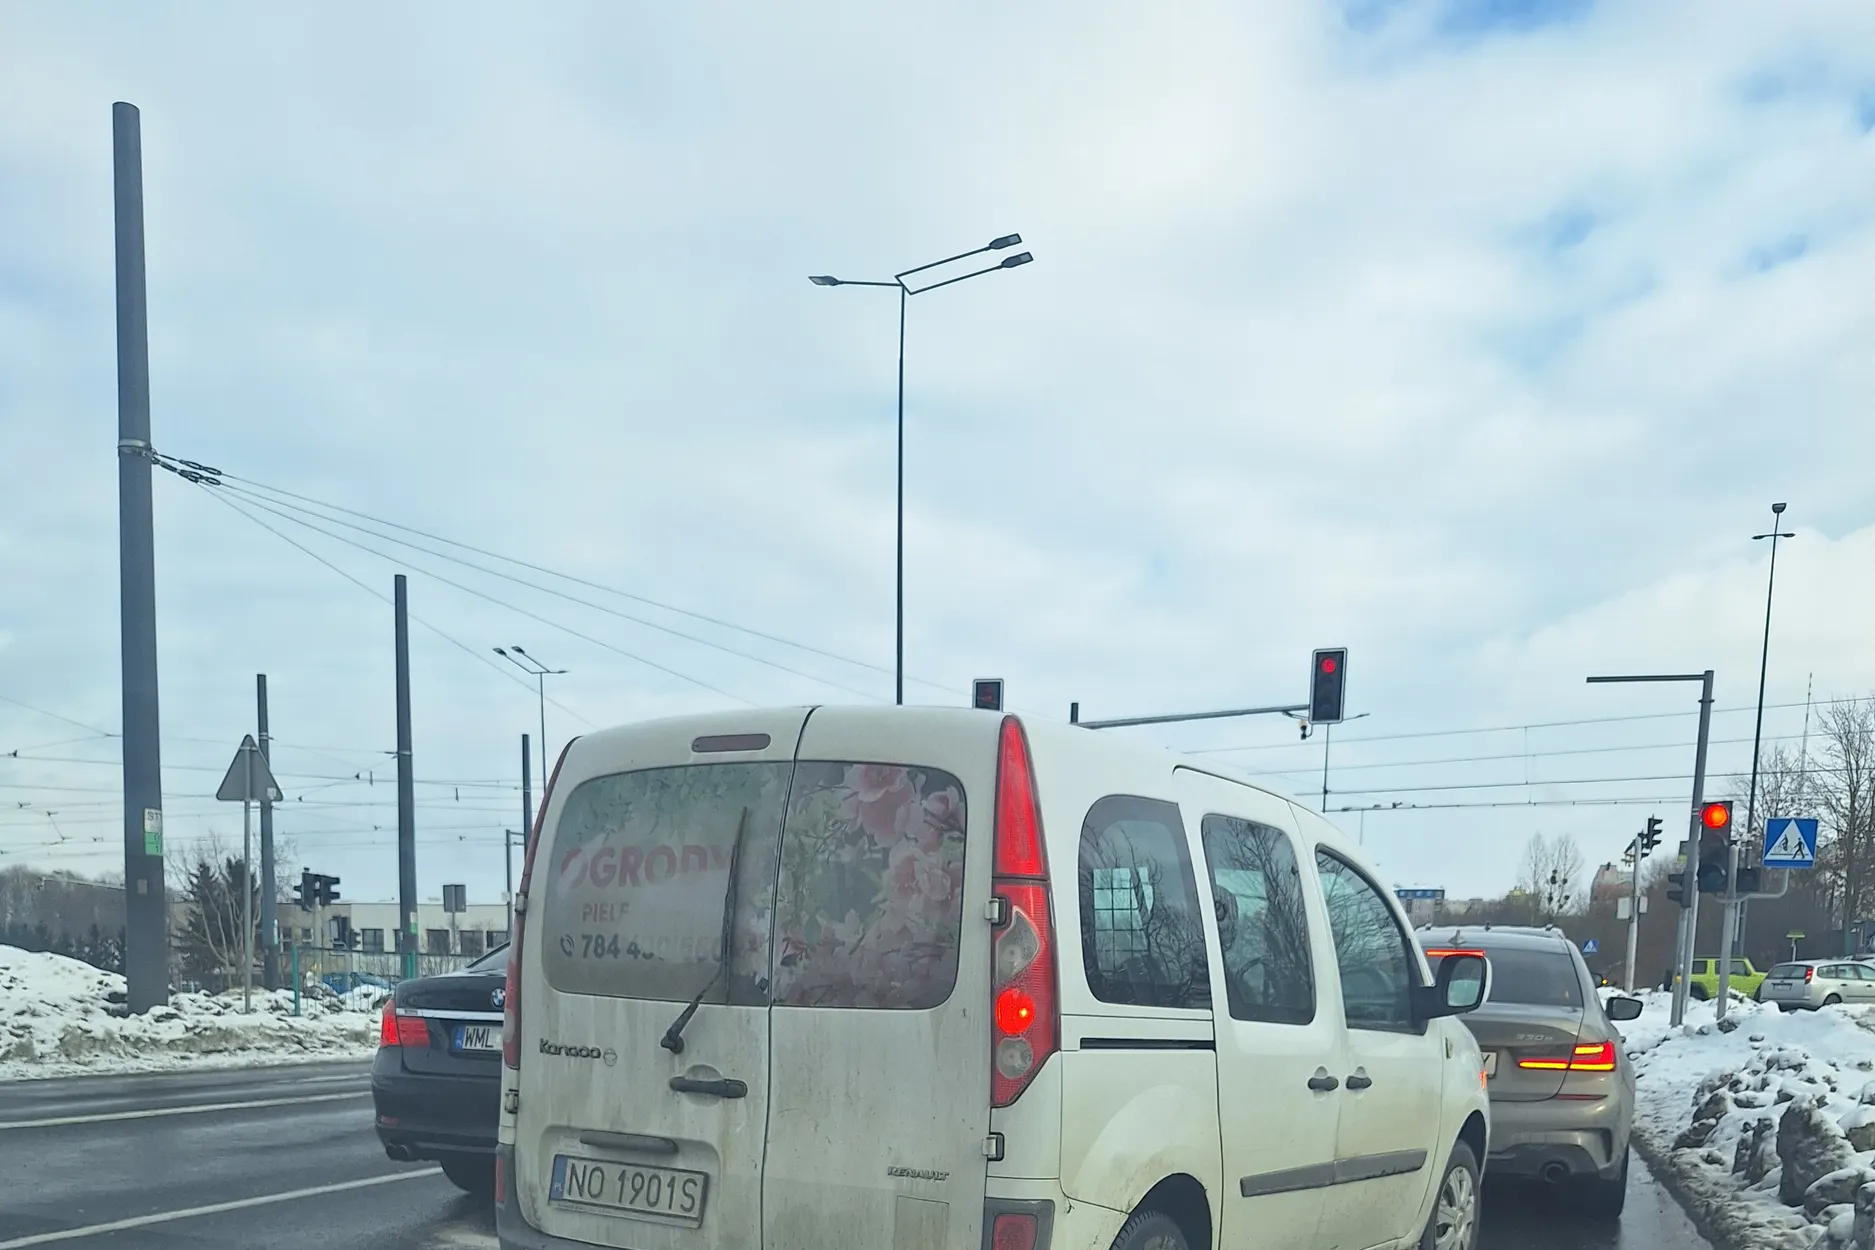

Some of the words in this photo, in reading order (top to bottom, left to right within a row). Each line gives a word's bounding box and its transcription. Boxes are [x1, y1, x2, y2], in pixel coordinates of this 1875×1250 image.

[581, 934, 621, 960] 784
[464, 1027, 494, 1048] WML
[539, 1038, 602, 1059] Kangoo
[887, 1165, 951, 1181] RENAULT
[568, 1163, 605, 1198] NO
[617, 1169, 698, 1212] 1901S
